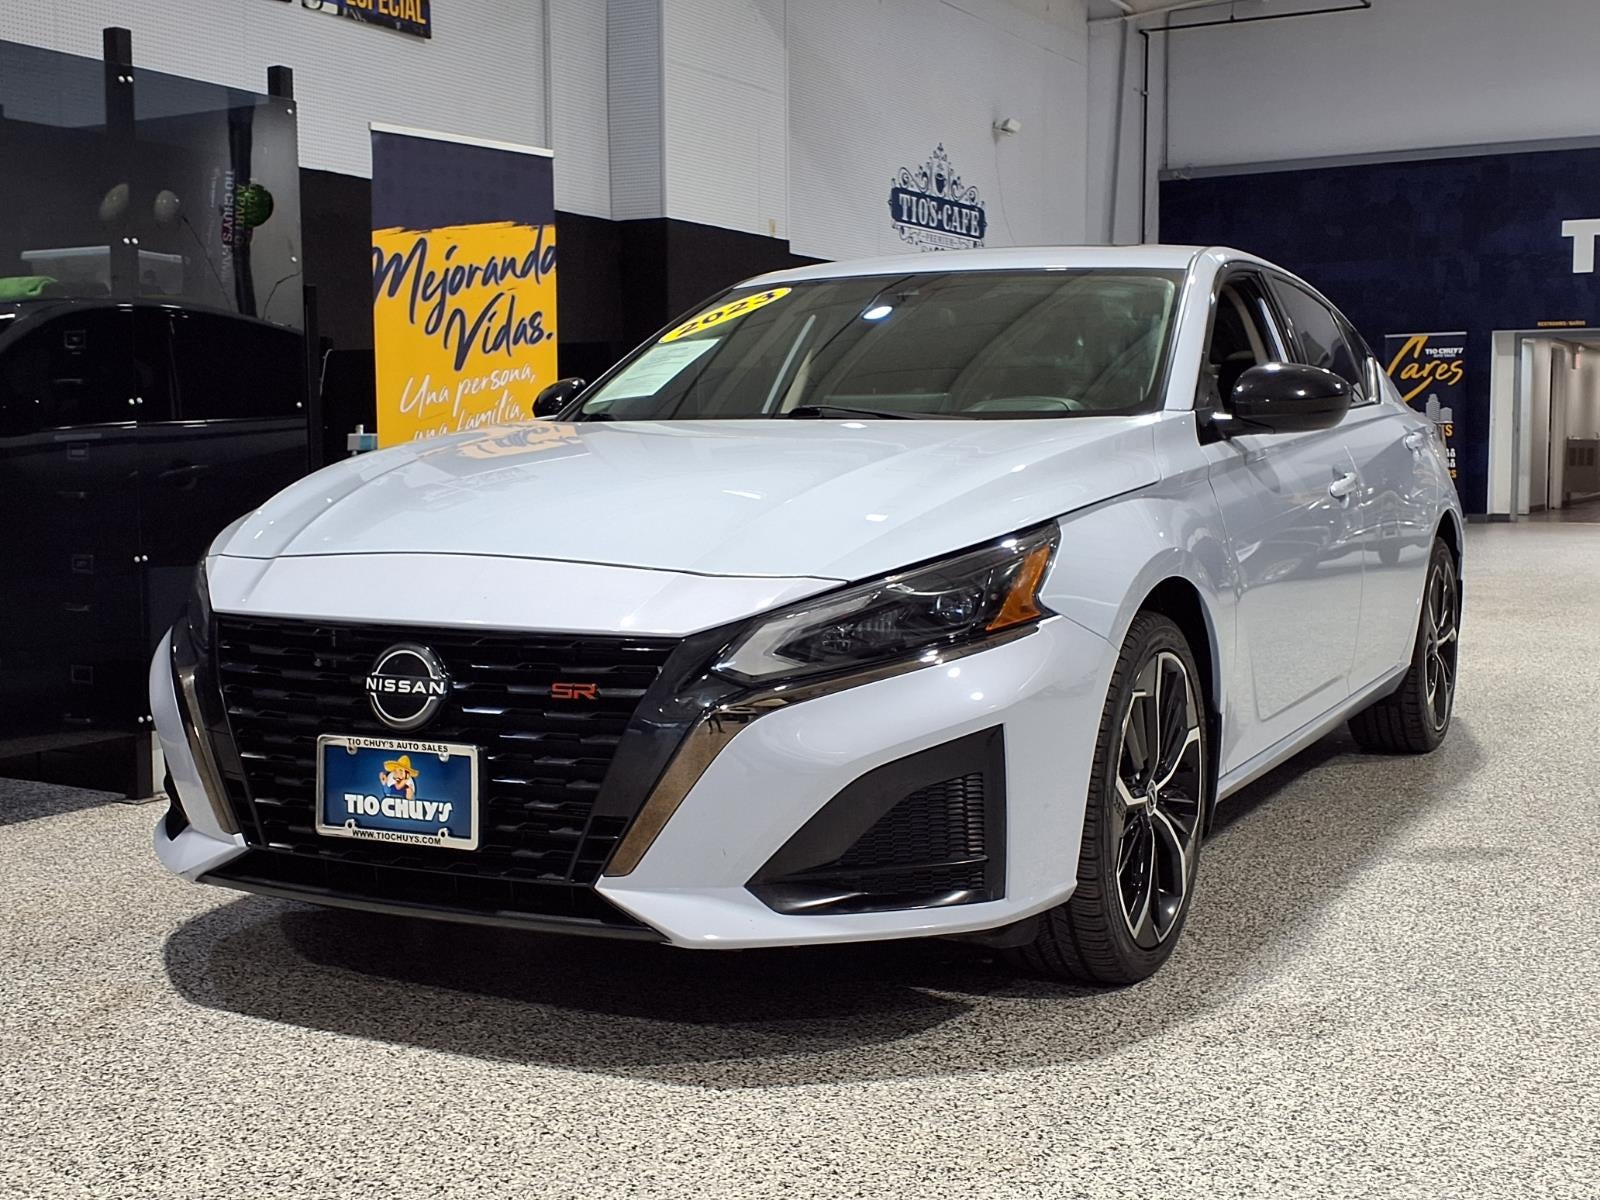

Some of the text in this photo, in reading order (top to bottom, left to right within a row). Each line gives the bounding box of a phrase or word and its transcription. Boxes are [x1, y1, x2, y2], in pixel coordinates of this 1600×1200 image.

[346, 0, 427, 25] ECIAL
[676, 291, 776, 337] 2023
[1386, 335, 1463, 402] Cares
[400, 363, 536, 418] Una persona,
[365, 676, 445, 695] NISSAN
[551, 683, 597, 699] SR
[346, 738, 449, 753] TIO CHUY'S AUTO SALES
[344, 793, 380, 816] TIO
[352, 828, 442, 845] WWW.TIOCHUYS.COM
